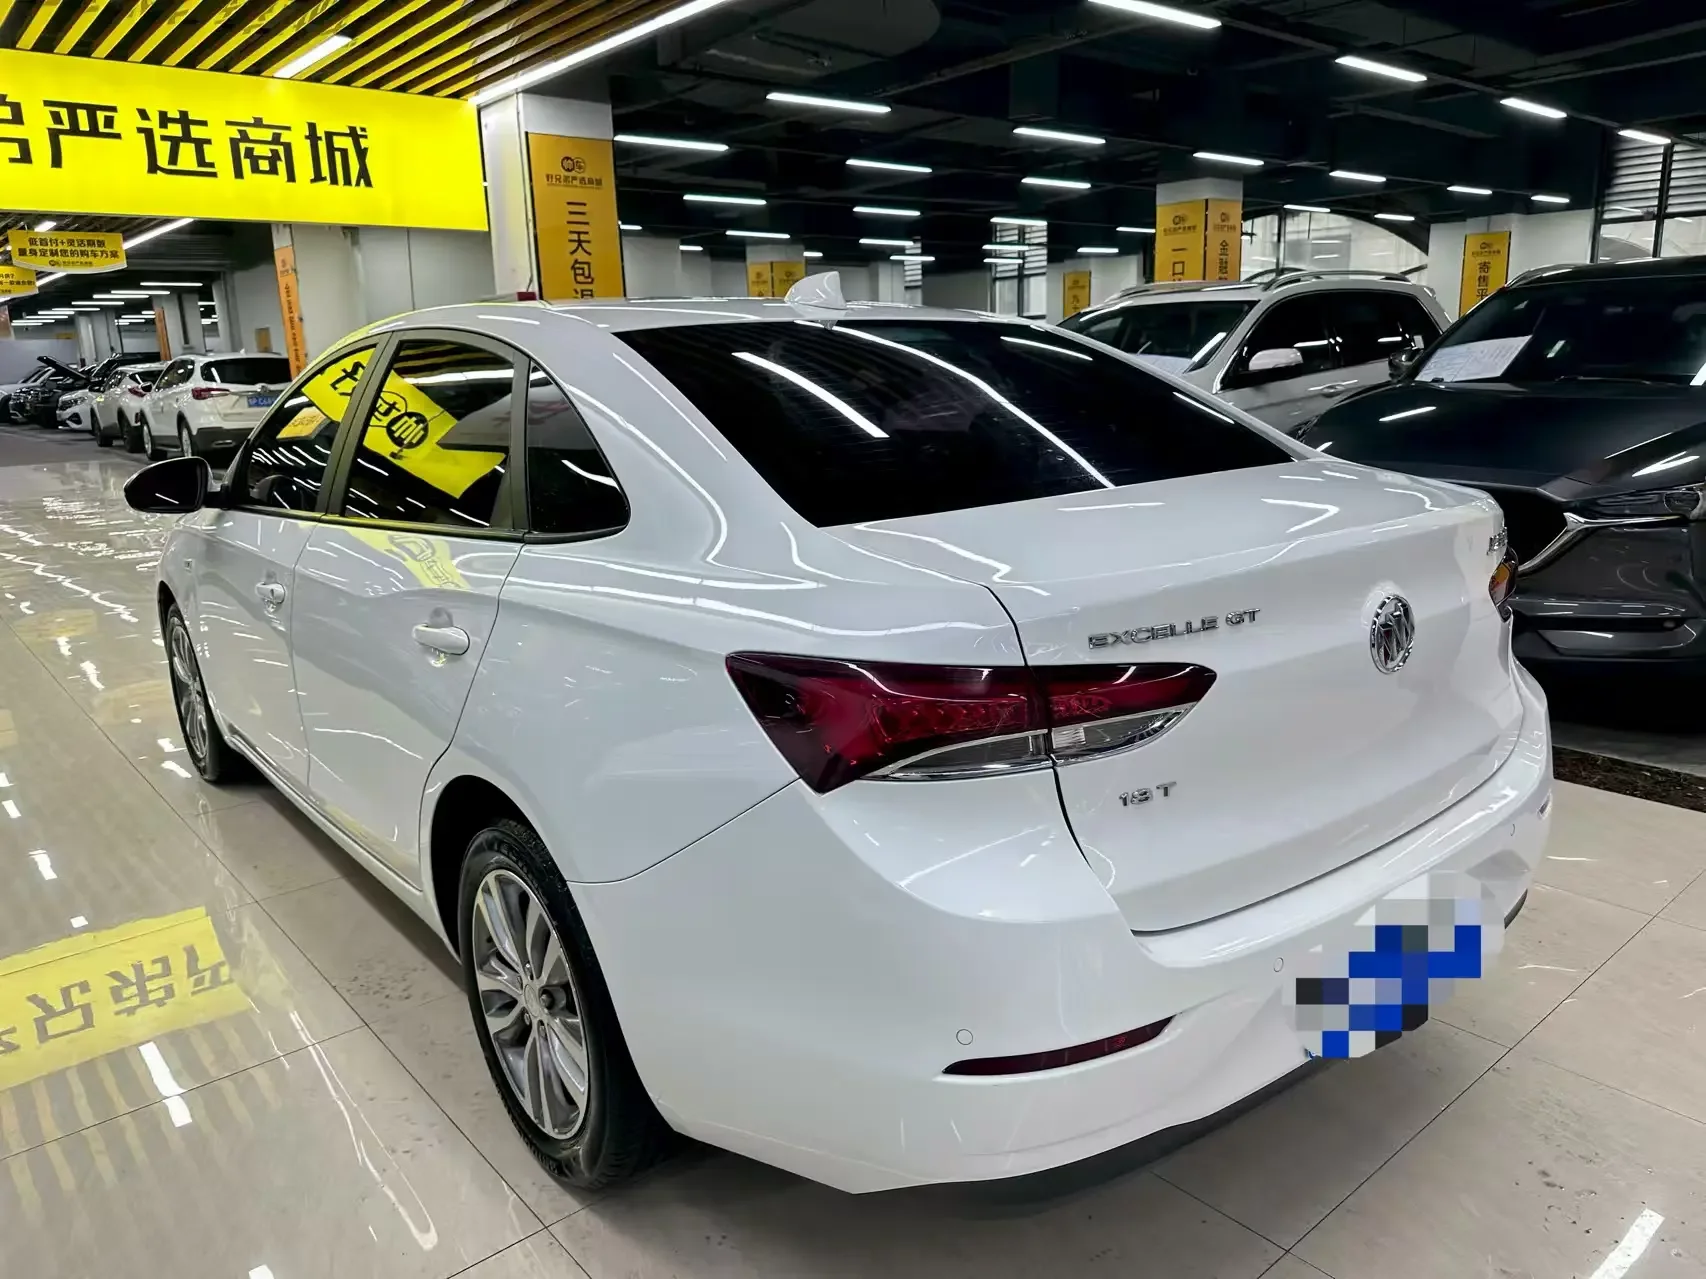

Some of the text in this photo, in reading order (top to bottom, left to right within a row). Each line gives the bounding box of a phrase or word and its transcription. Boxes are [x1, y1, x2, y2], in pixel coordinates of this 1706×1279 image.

[1171, 247, 1188, 282] 一口
[1218, 240, 1229, 281] 金融
[1088, 608, 1260, 650] EXCELLE GT
